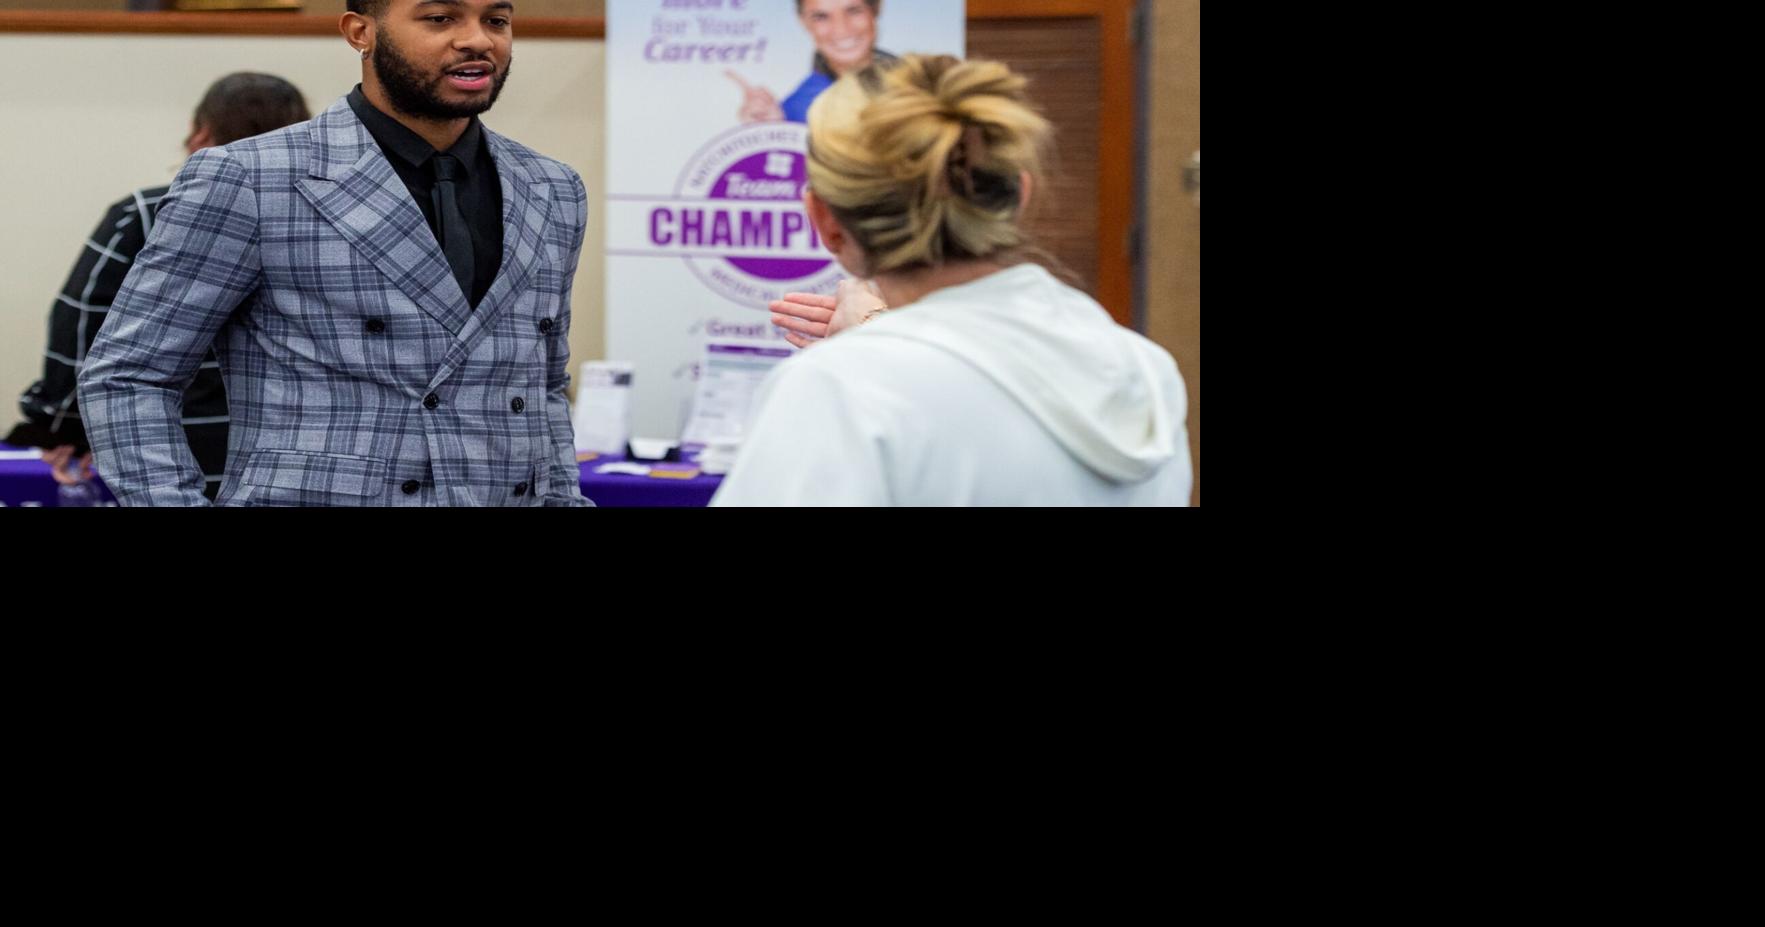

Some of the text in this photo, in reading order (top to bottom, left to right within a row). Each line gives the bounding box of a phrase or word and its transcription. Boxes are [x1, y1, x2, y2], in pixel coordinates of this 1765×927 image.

[652, 15, 759, 36] for Your
[643, 35, 769, 63] Career!
[724, 172, 796, 198] Team
[706, 320, 767, 339] Great
